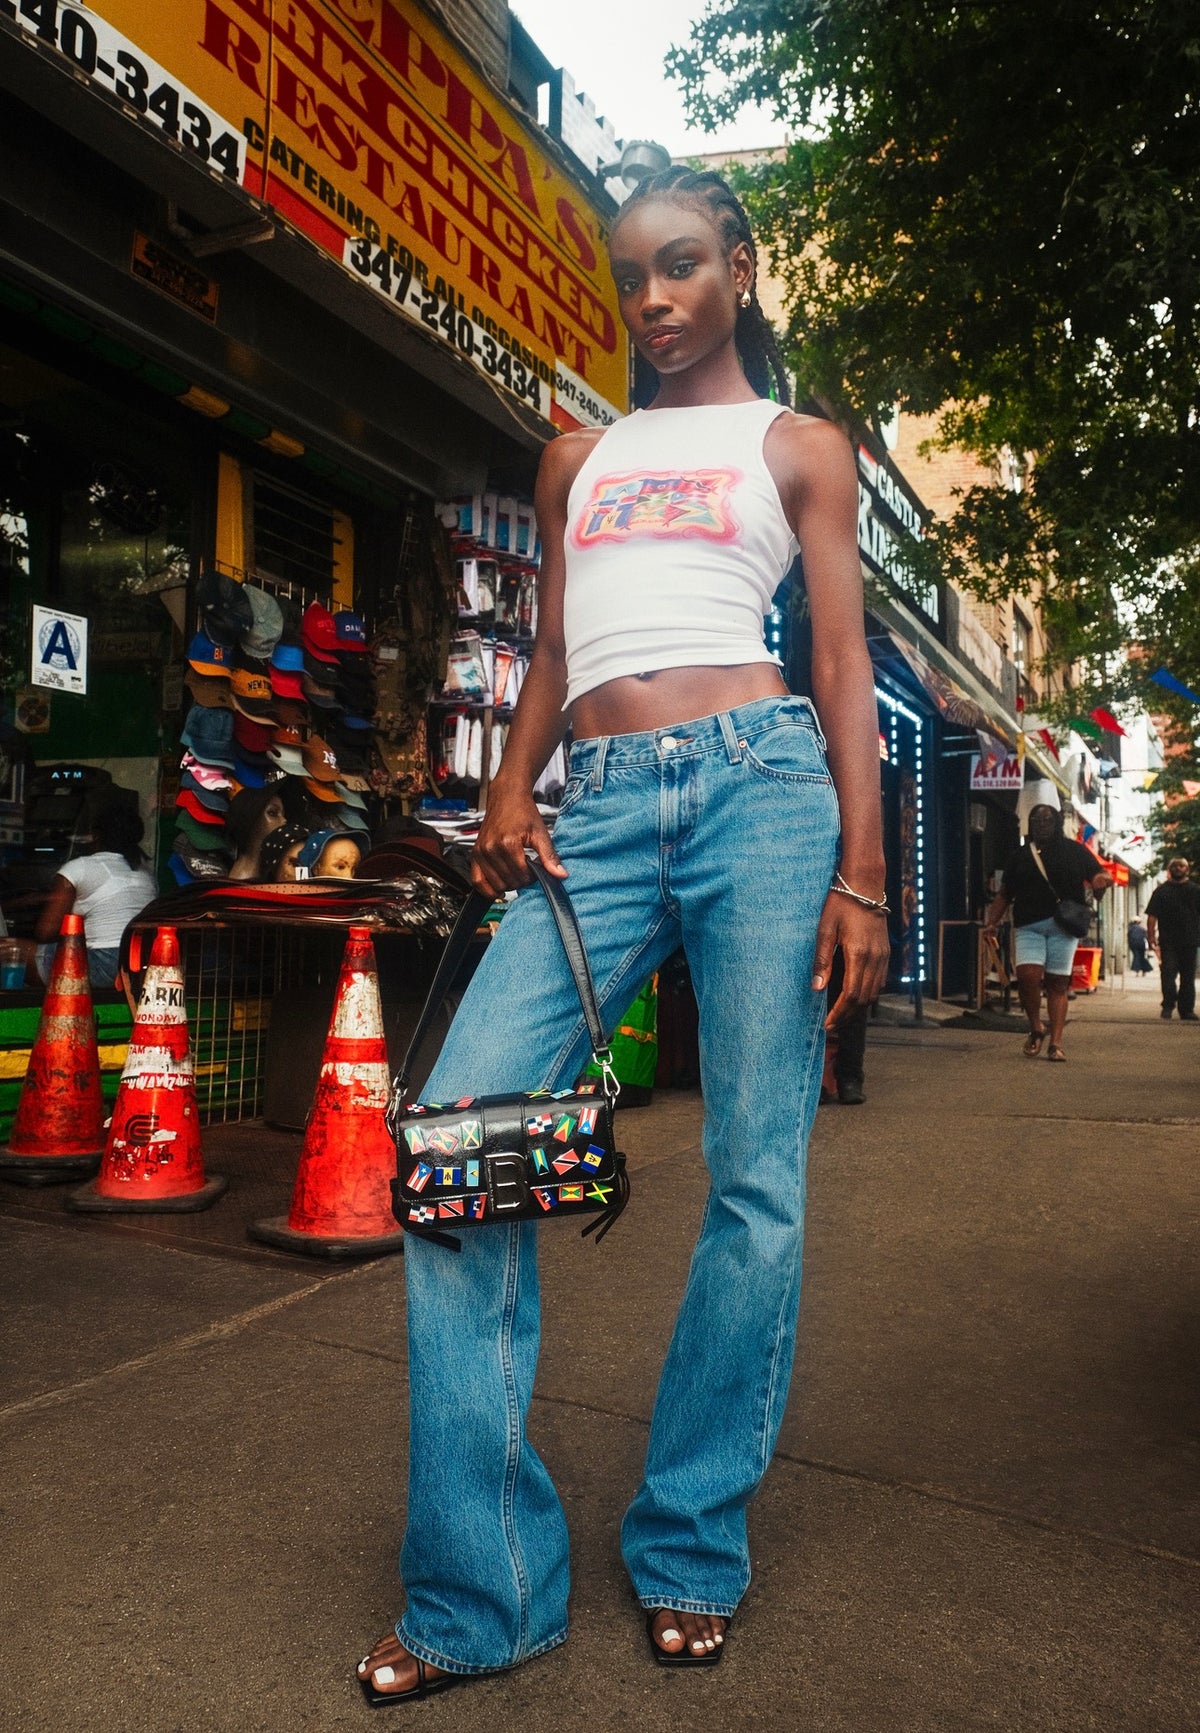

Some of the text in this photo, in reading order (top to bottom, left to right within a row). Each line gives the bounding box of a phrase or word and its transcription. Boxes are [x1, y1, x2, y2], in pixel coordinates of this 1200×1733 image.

[0, 0, 241, 184] 40-3434
[197, 0, 594, 381] RESTAURANT
[243, 117, 381, 244] CATERING
[386, 233, 431, 288] FOR
[433, 274, 466, 316] ALL
[386, 102, 601, 335] CHICKEN
[351, 238, 541, 411] 347-240-3434
[556, 372, 618, 426] 347-240-34
[41, 620, 77, 670] A
[52, 771, 83, 780] ATM
